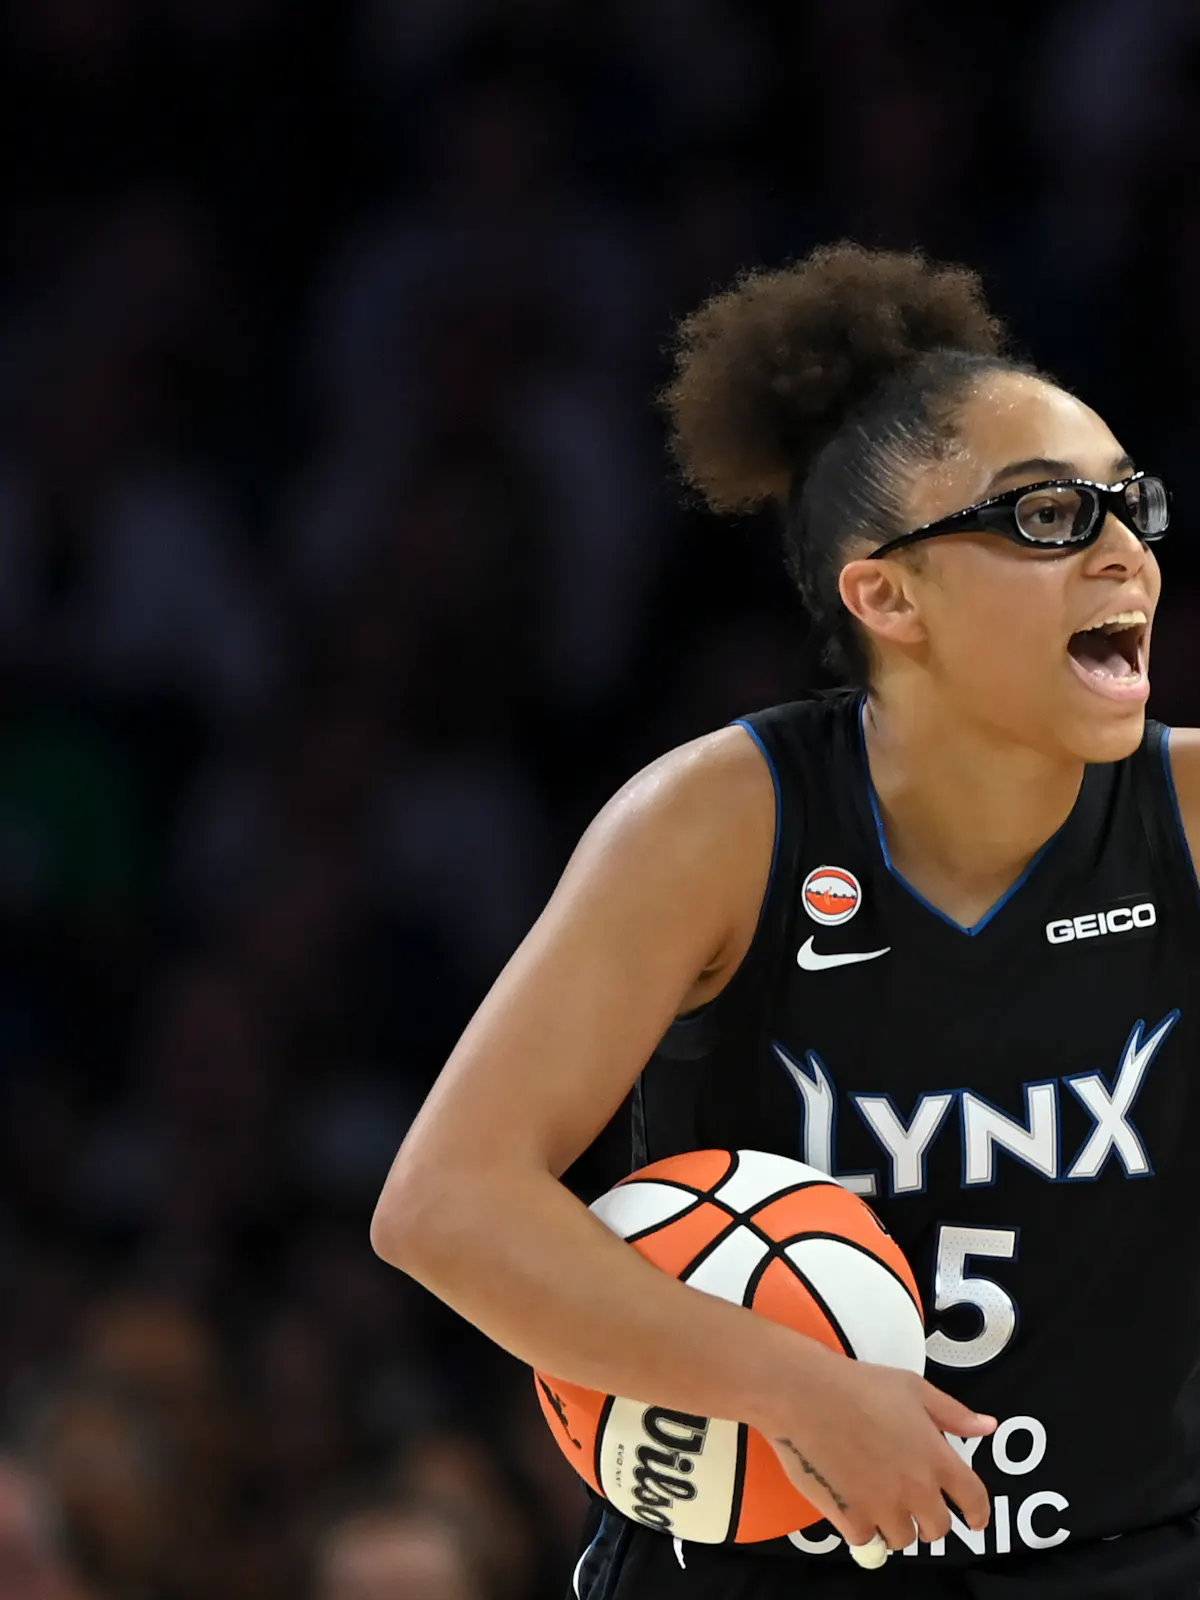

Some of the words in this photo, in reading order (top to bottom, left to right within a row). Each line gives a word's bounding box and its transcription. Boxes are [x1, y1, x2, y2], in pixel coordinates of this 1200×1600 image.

[1045, 902, 1157, 945] GEICO
[770, 1008, 1182, 1198] LYNX
[925, 1222, 1020, 1370] 5
